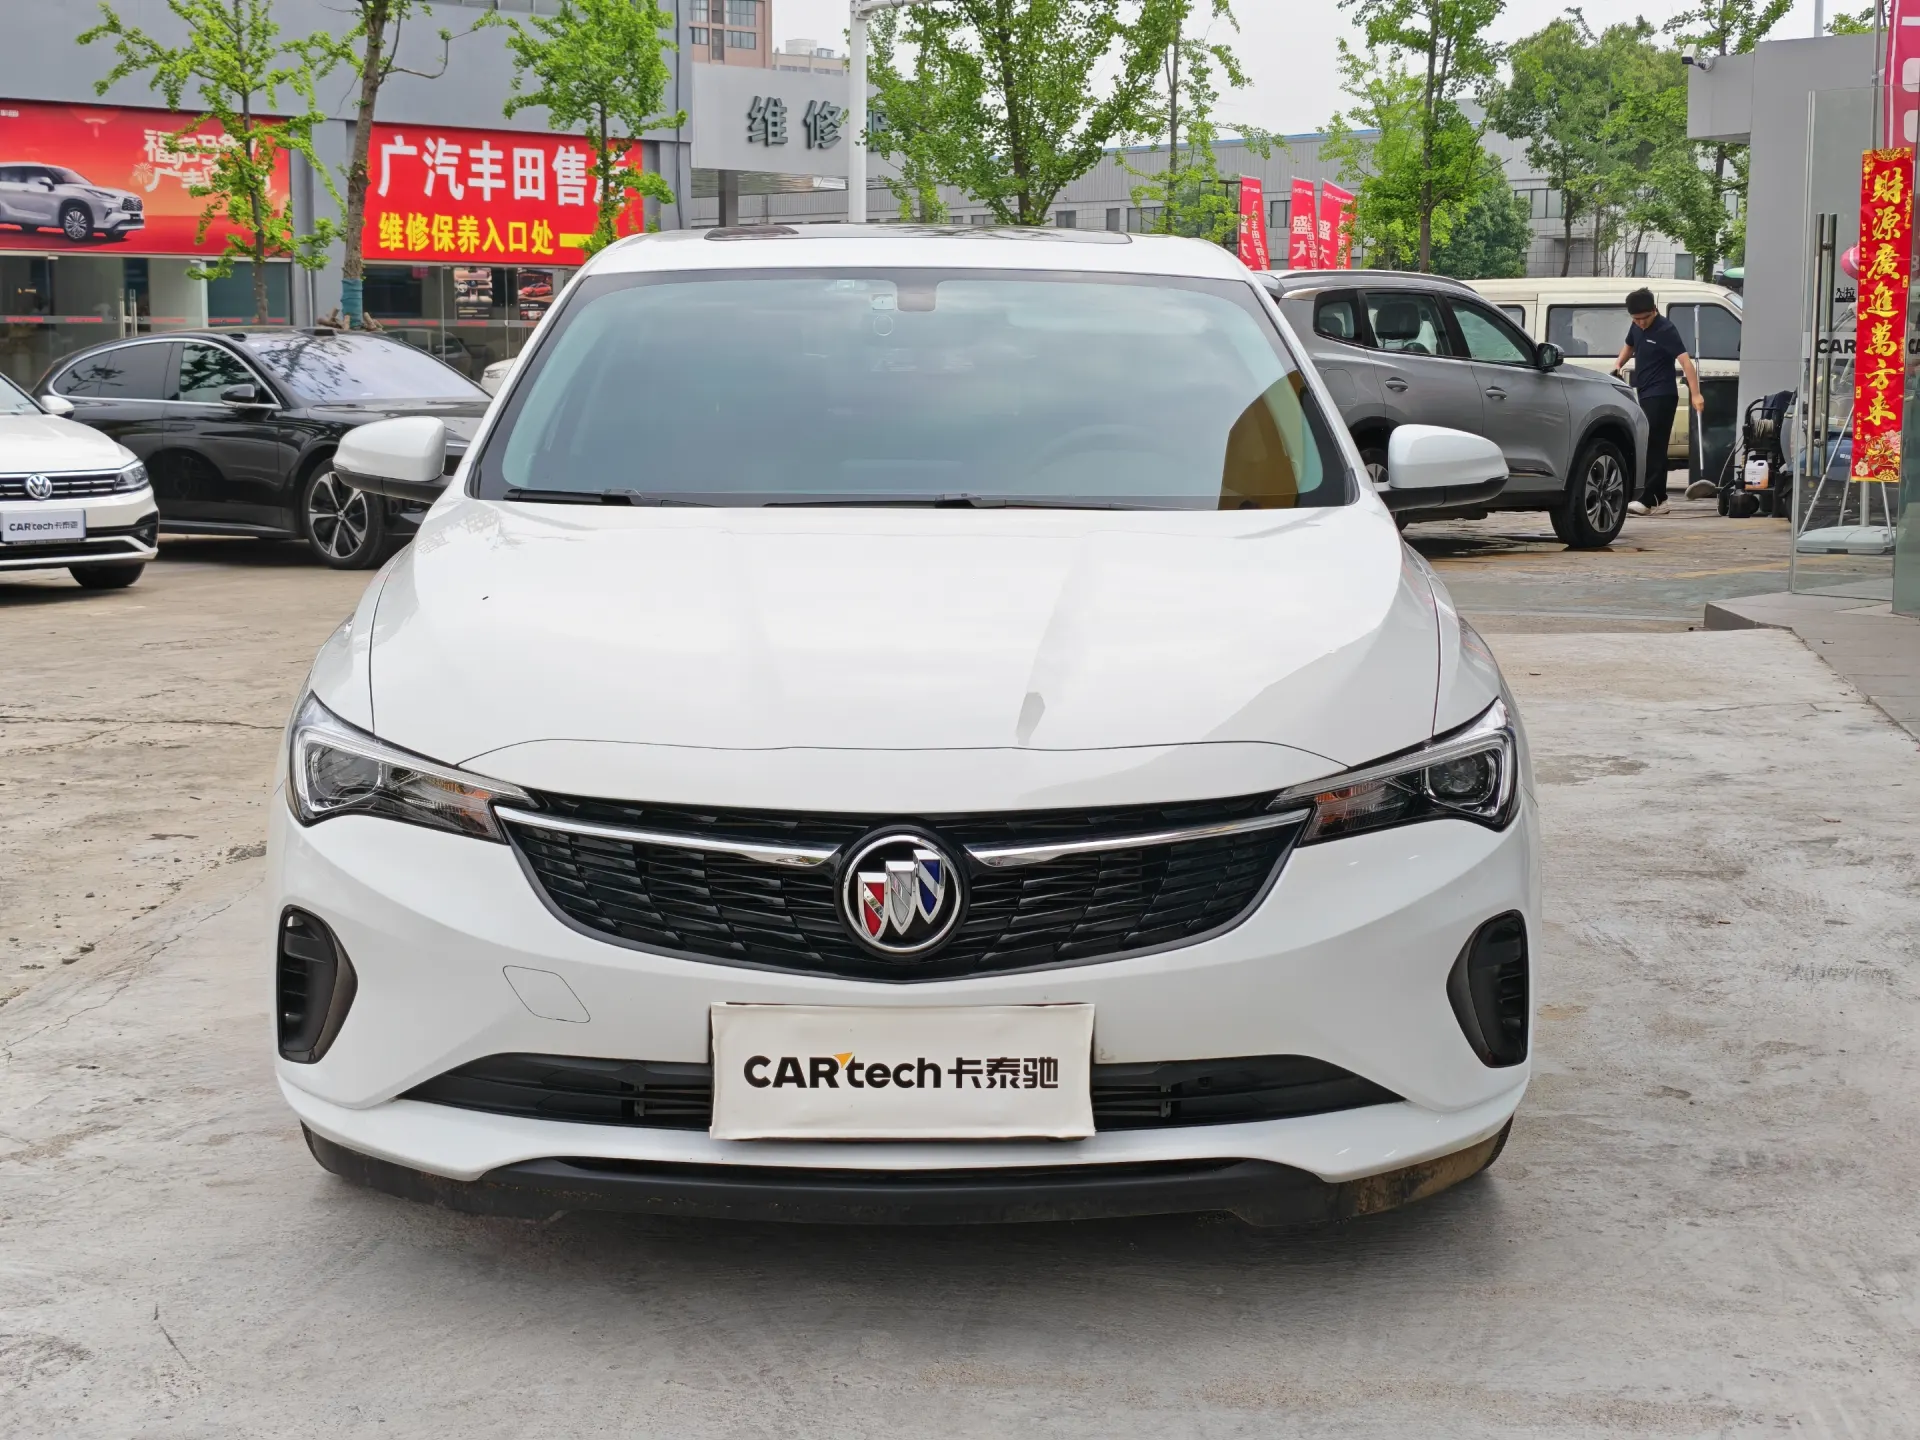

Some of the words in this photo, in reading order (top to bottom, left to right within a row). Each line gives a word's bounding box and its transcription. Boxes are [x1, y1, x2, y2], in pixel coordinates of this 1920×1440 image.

[379, 212, 554, 255] 维修保养入口处
[1292, 215, 1309, 270] 盛大
[9, 522, 54, 531] CARtech
[743, 1053, 942, 1089] CARtech
[948, 1056, 1059, 1089] 卡泰驰
